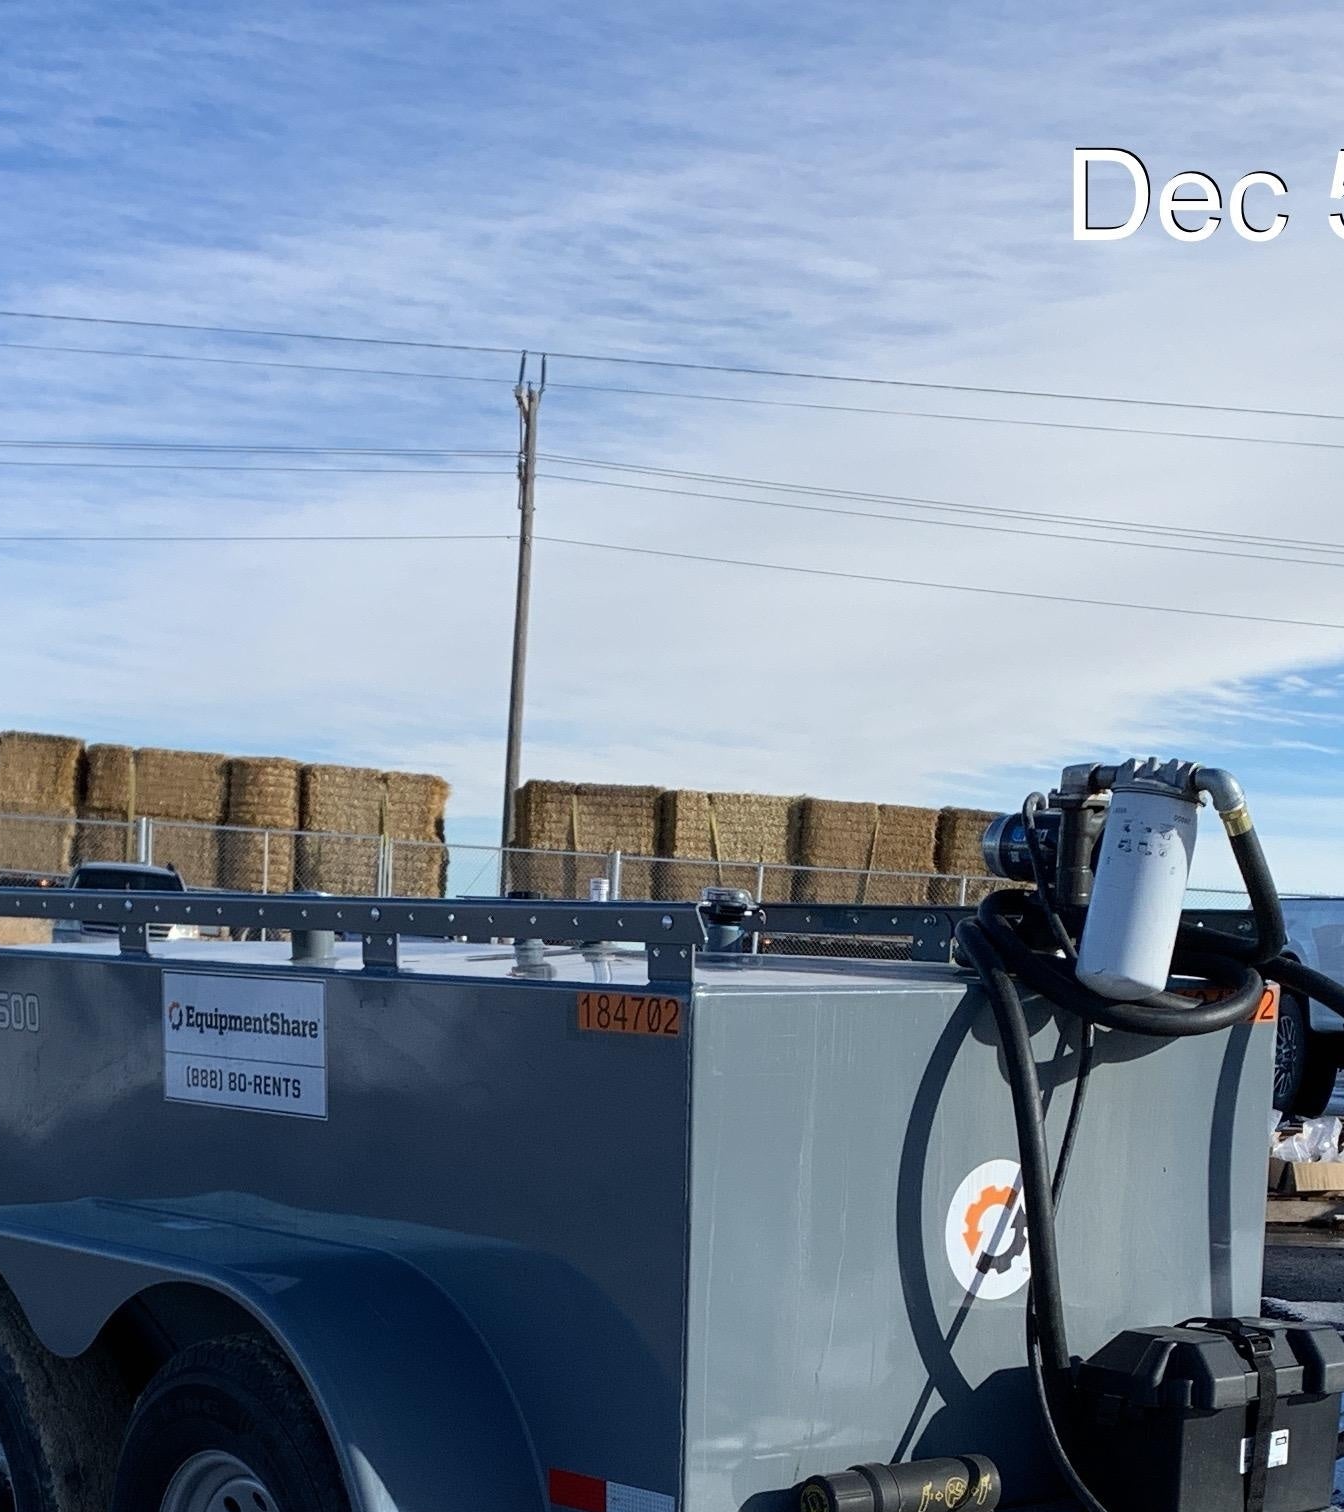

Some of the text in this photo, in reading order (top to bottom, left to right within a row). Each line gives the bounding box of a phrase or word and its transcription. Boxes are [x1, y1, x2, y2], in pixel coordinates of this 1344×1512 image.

[185, 1005, 318, 1039] EquipmentShare
[581, 995, 678, 1035] 184702
[186, 1065, 301, 1099] (888) 80-RENTS
